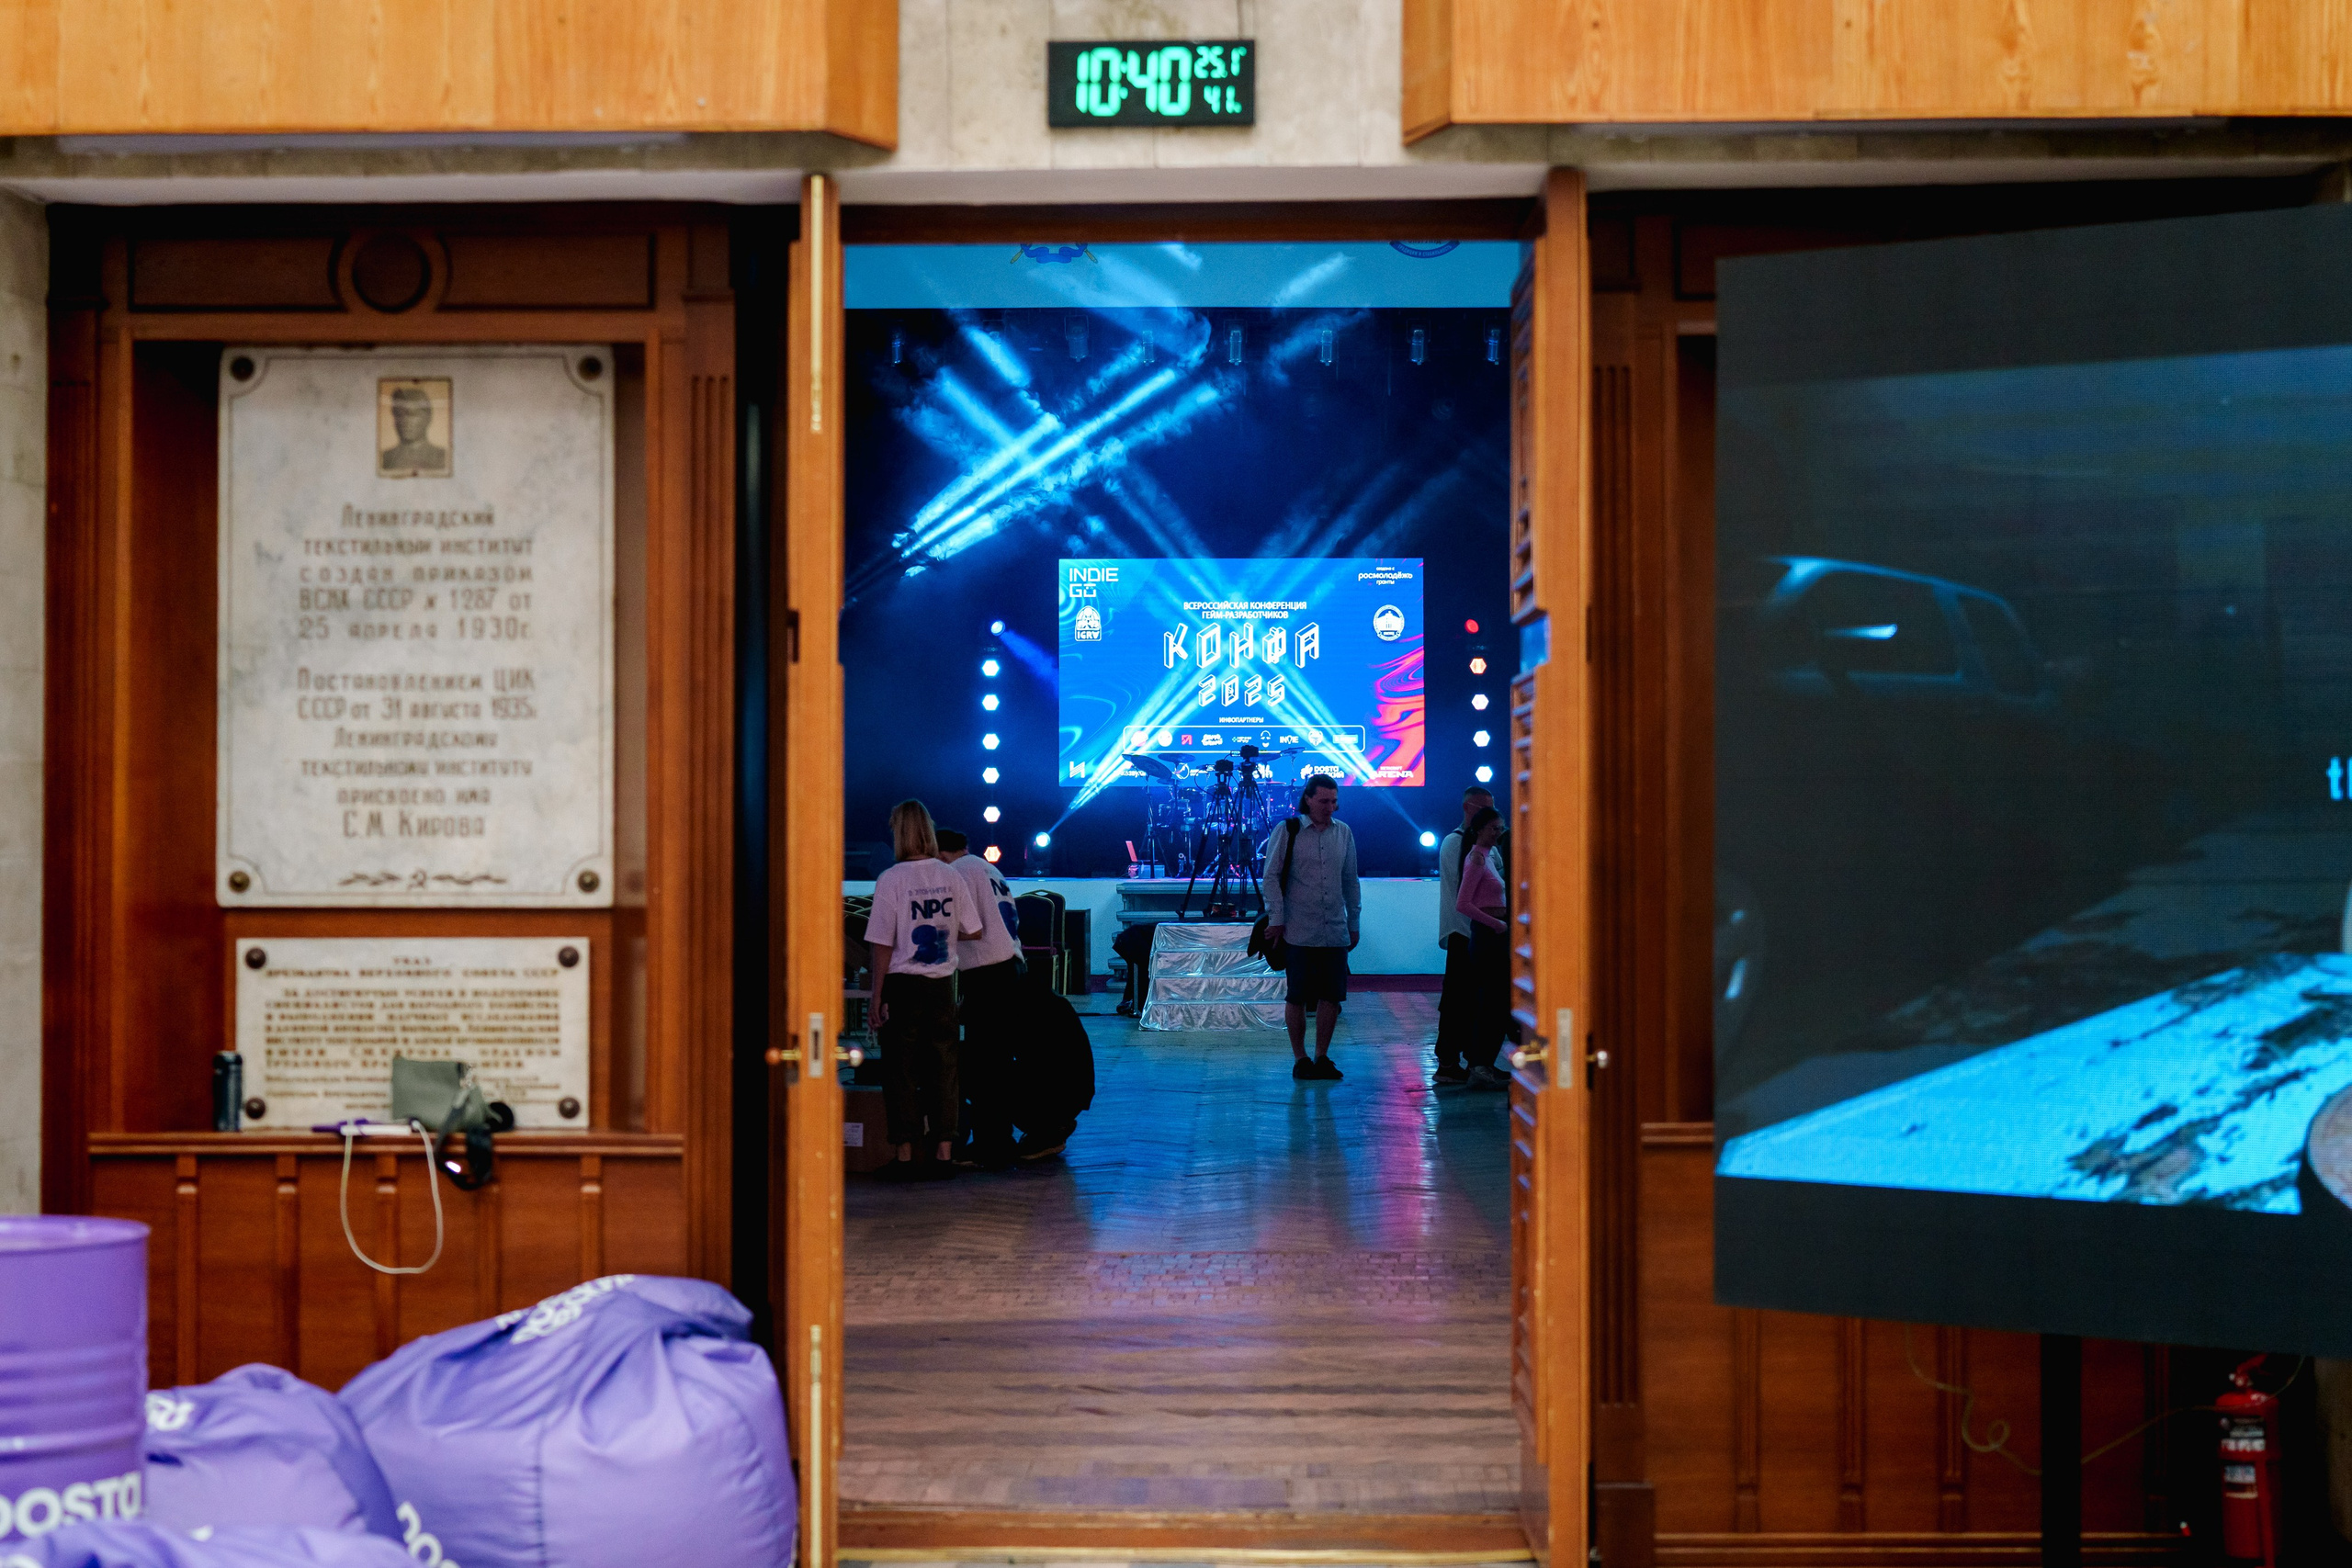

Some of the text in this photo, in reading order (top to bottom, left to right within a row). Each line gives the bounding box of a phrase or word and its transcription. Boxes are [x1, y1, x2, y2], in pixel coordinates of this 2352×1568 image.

[1076, 46, 1193, 117] 10:40
[1069, 568, 1119, 581] INDIE
[1183, 601, 1306, 611] ВСЕРОССИЙСКАЯ КОНФЕРЕНЦИЯ
[1202, 610, 1289, 619] ГЕЙМ-РАЗРАБОТЧИКОВ
[298, 617, 330, 640] 25
[1163, 622, 1319, 669] КОНФА
[1198, 673, 1285, 707] 2025
[2326, 756, 2352, 800] t
[911, 897, 953, 920] NPC
